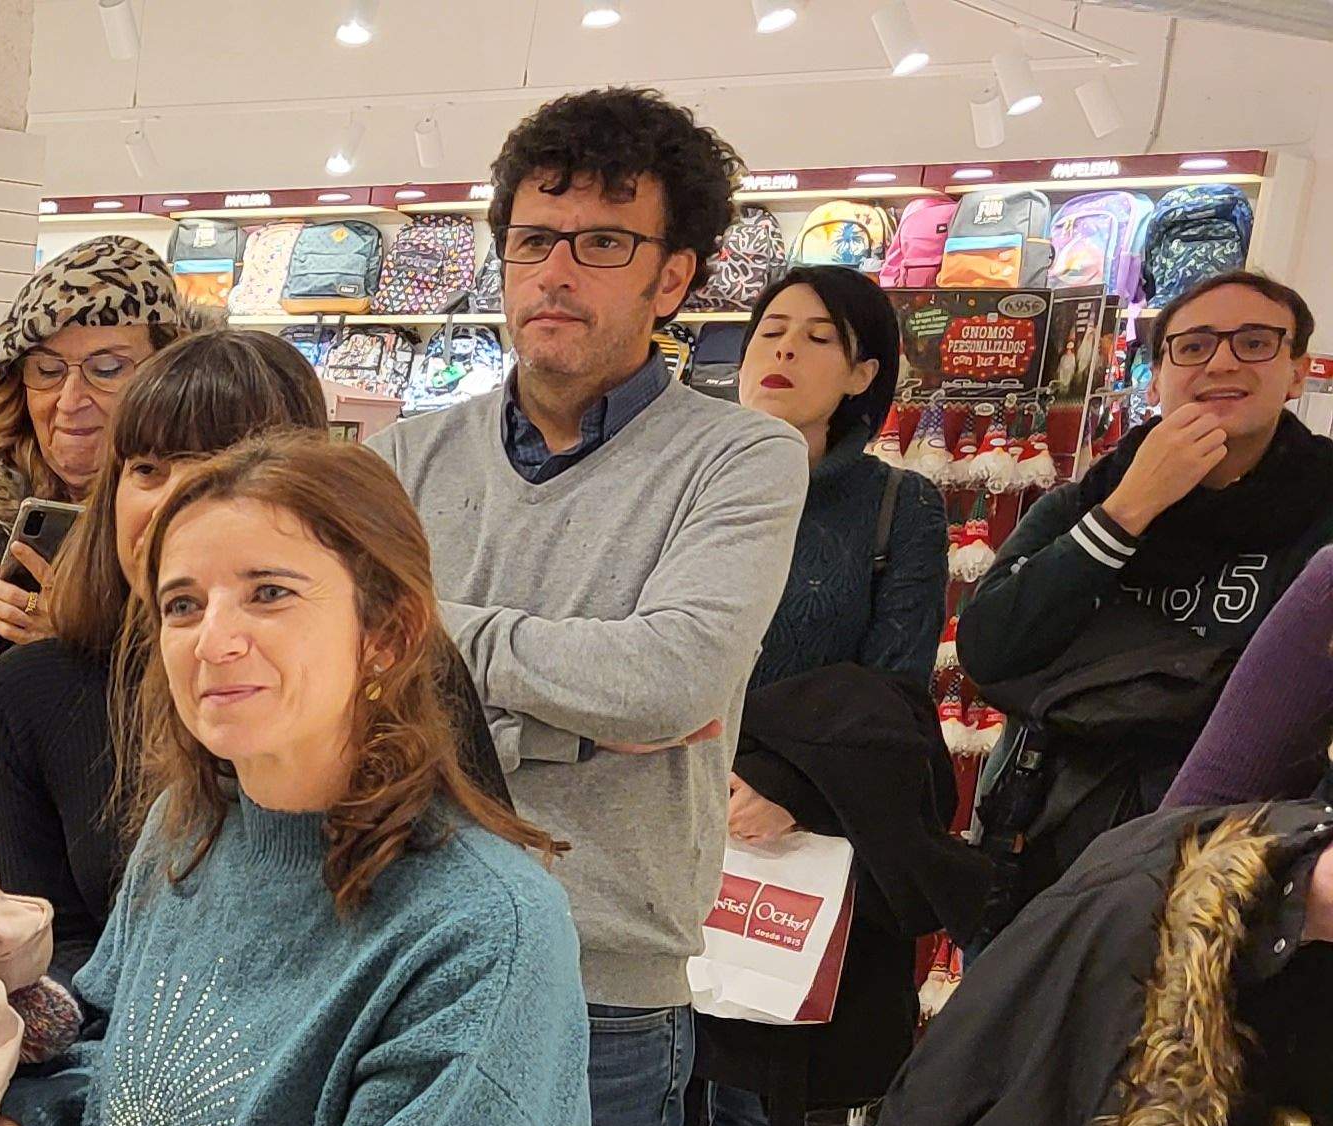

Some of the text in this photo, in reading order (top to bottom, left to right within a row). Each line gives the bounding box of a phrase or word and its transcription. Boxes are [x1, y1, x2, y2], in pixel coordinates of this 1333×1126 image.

[1050, 159, 1119, 179] PAPELERÍA
[961, 325, 1015, 339] GNOMOS
[947, 340, 1026, 354] PERSONALIZADOS
[952, 353, 1017, 368] con luz led
[755, 902, 811, 932] OCHOA
[754, 928, 801, 947] desde 1915
